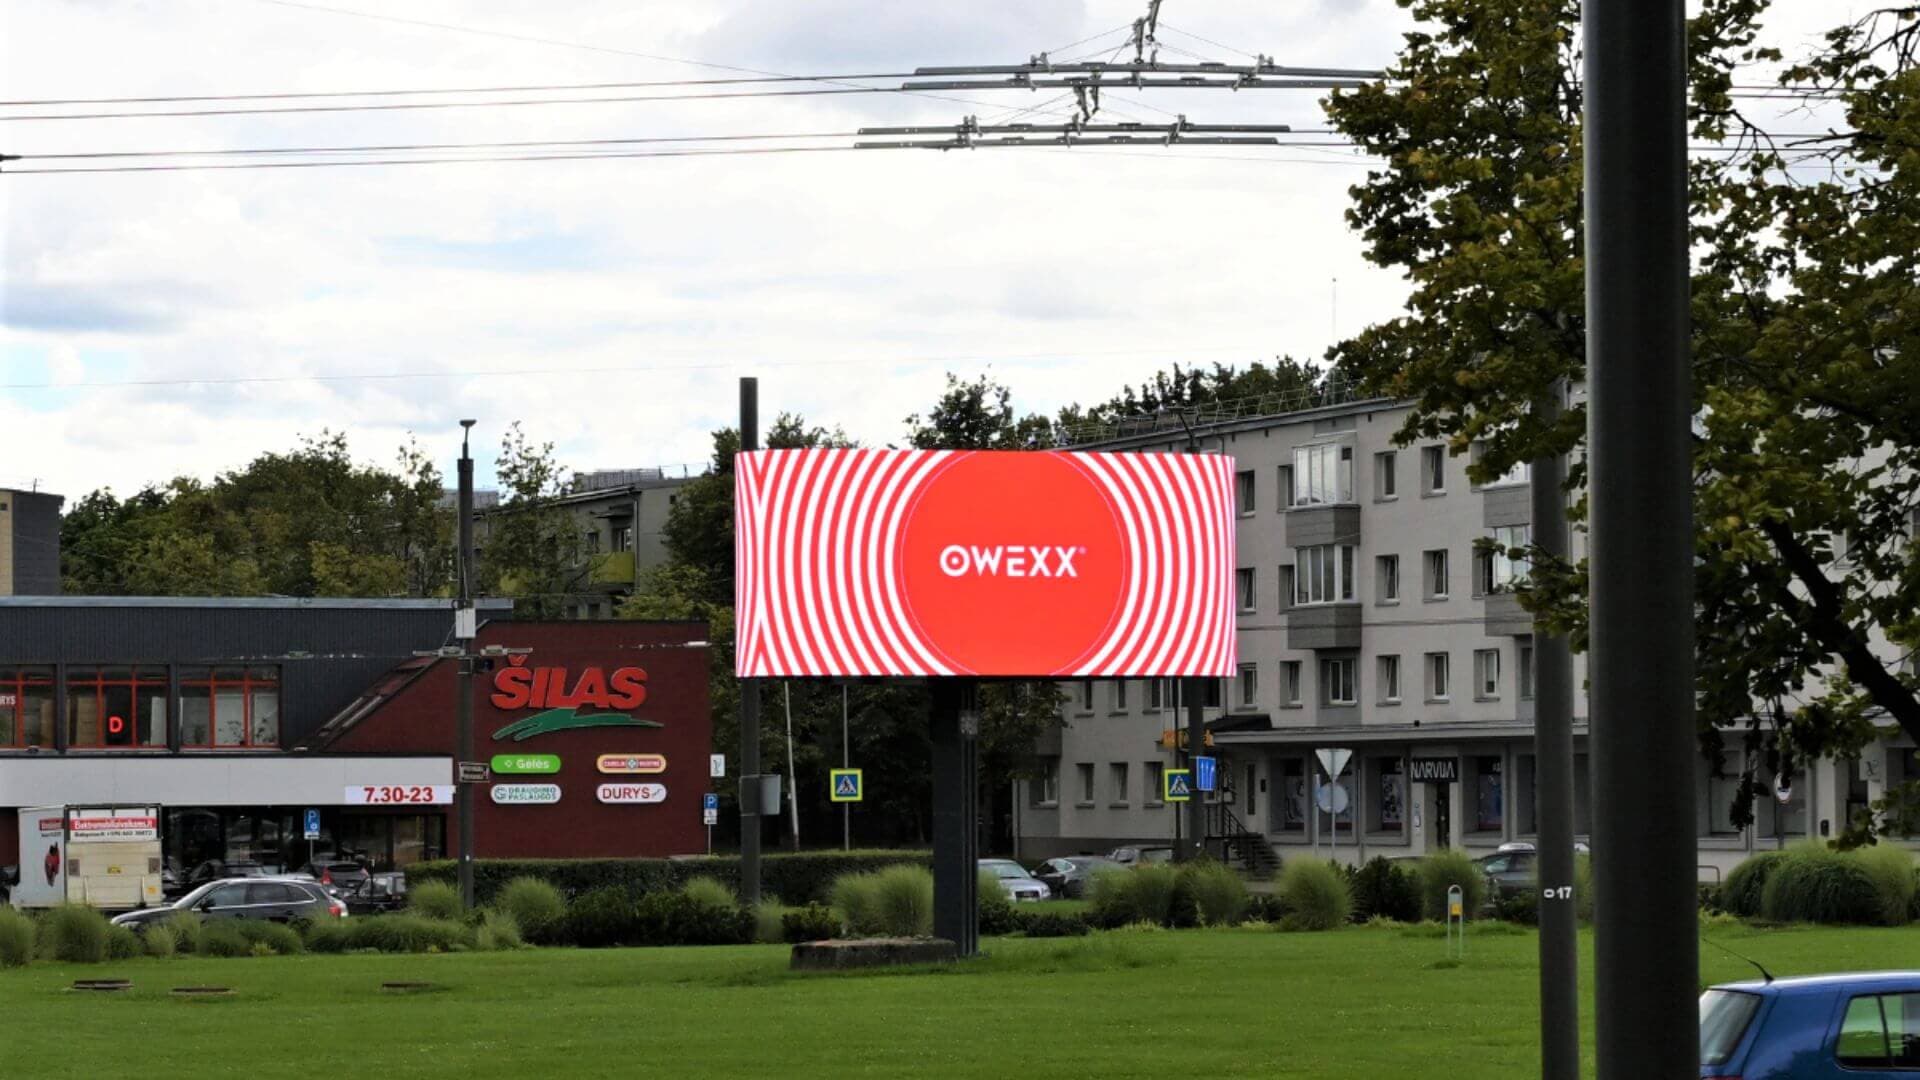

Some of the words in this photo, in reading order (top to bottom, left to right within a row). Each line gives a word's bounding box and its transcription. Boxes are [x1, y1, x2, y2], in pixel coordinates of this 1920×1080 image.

[939, 544, 1078, 577] OWEXX
[491, 655, 649, 710] ŠILAS
[109, 716, 123, 733] D
[364, 787, 434, 803] 7.30-23
[602, 787, 650, 799] DURYS
[308, 810, 316, 822] P
